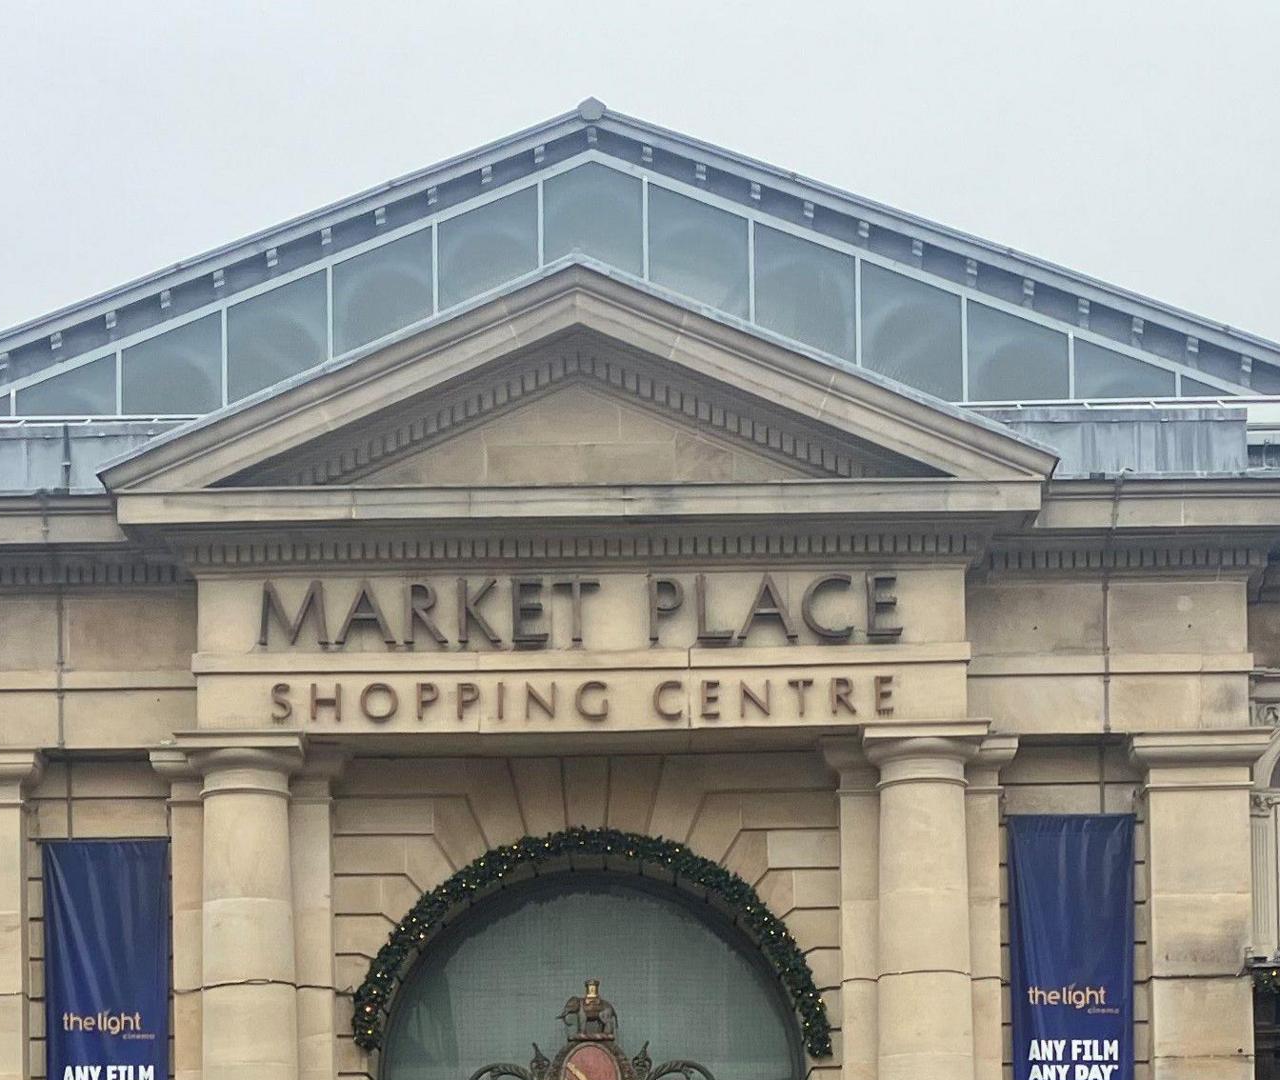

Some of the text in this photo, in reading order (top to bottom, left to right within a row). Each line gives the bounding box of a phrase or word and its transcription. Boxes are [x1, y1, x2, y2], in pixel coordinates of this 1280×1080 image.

[258, 571, 904, 646] MARKET PLACE
[271, 675, 895, 724] SHOPPING CENTRE
[1028, 1039, 1119, 1061] ANY FILM
[1028, 1064, 1071, 1080] ANY
